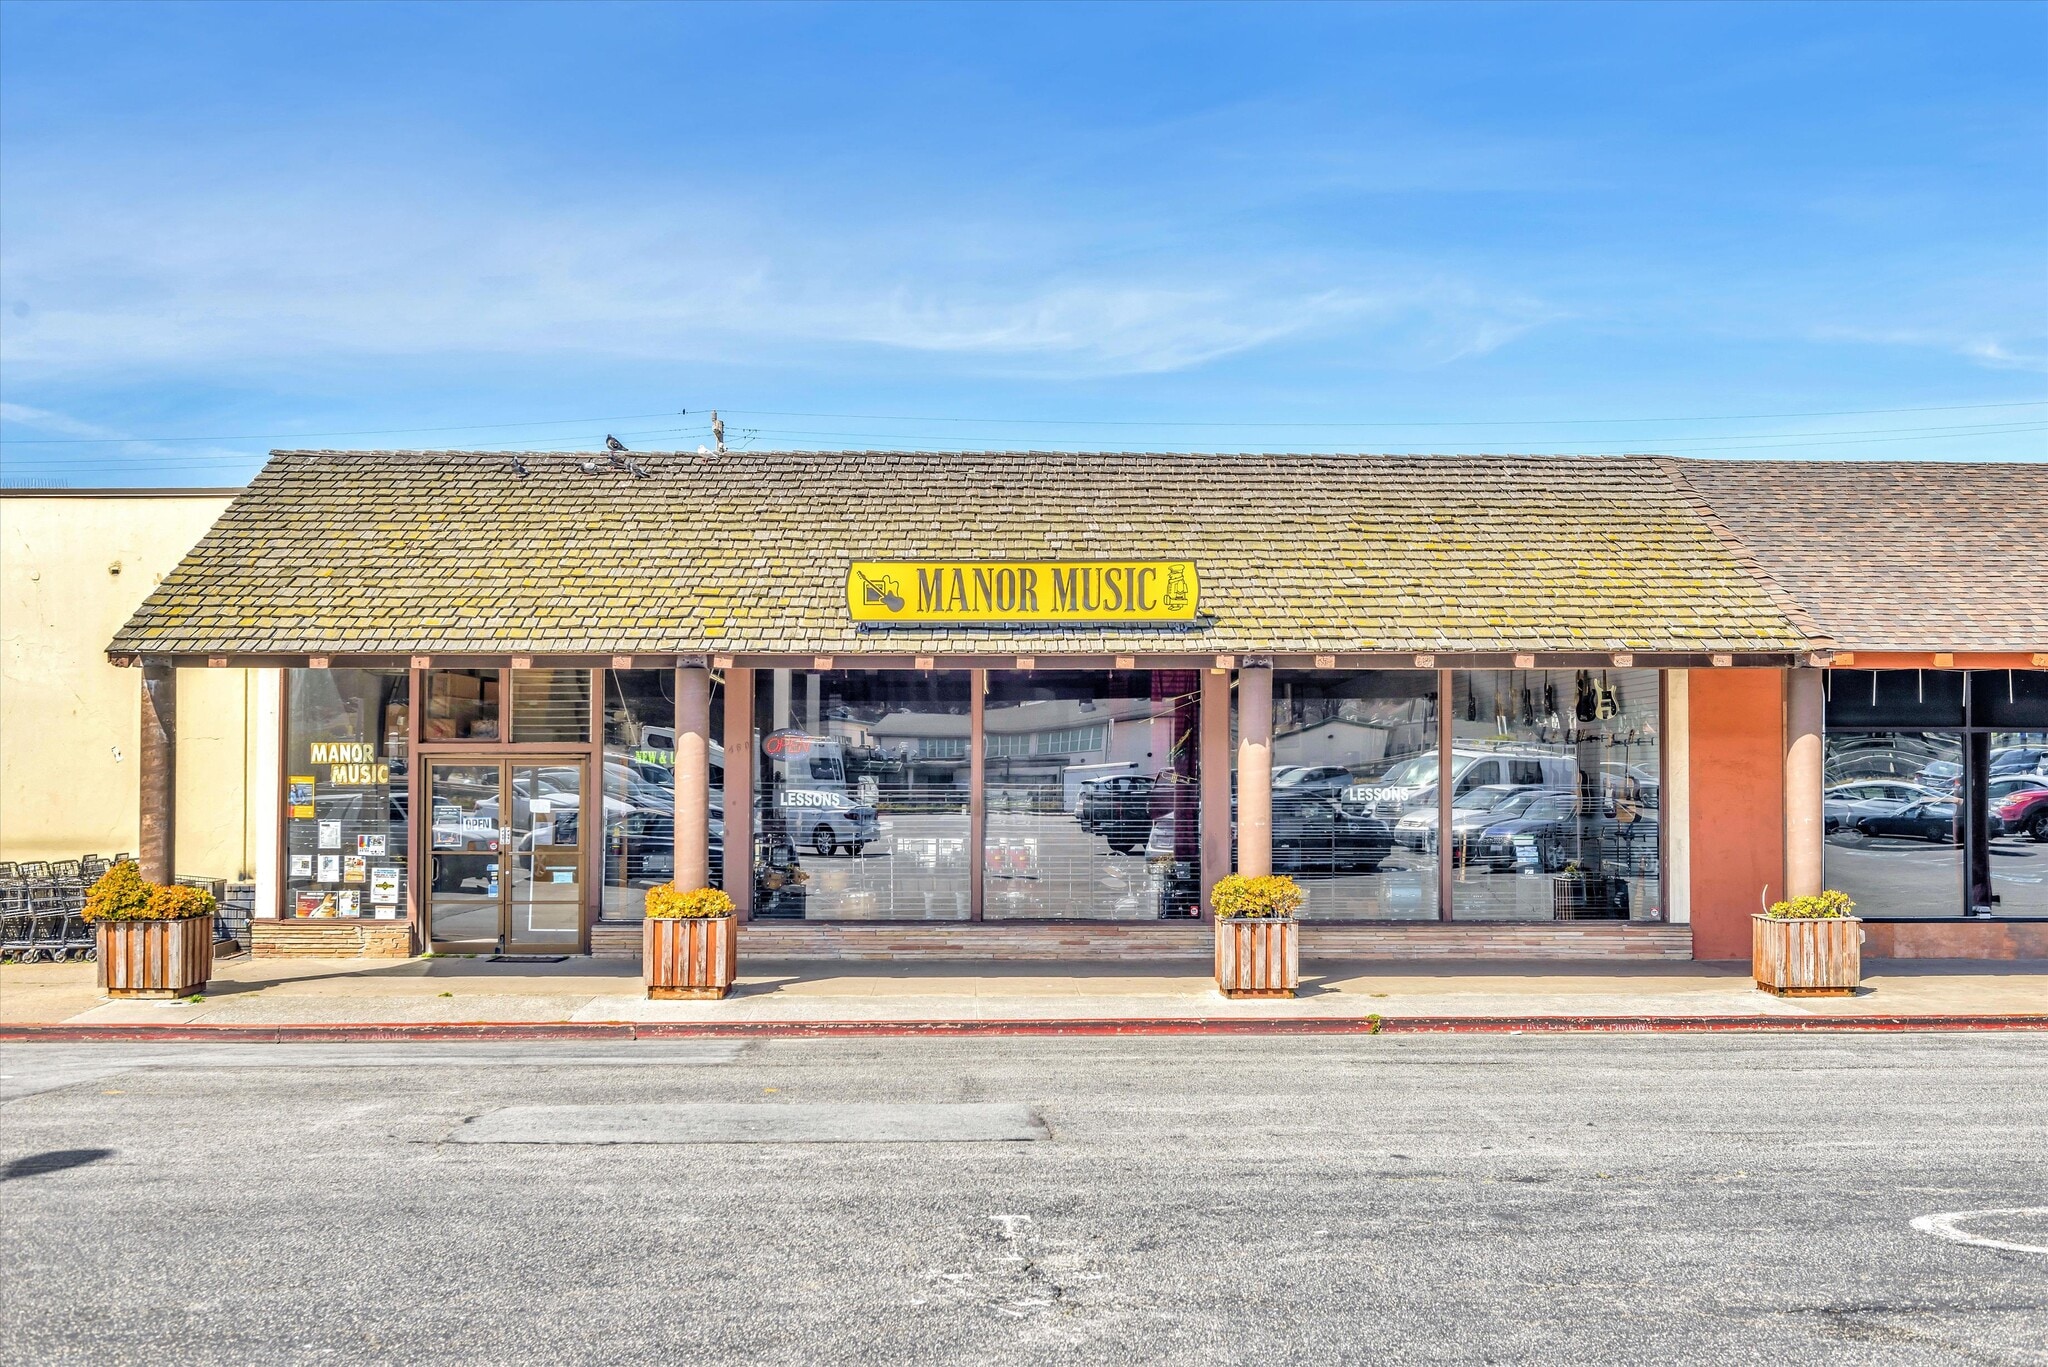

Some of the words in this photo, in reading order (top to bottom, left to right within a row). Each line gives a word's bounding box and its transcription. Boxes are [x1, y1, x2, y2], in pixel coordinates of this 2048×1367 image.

[916, 567, 1039, 613] MANOR
[1050, 567, 1158, 613] MUSIC
[766, 735, 812, 754] OPEN
[311, 743, 374, 763] MANOR
[635, 750, 657, 764] NEW
[331, 764, 389, 784] MUSIC
[780, 792, 840, 806] LESSONS
[1349, 787, 1409, 801] LESSONS
[465, 818, 490, 831] OPEN
